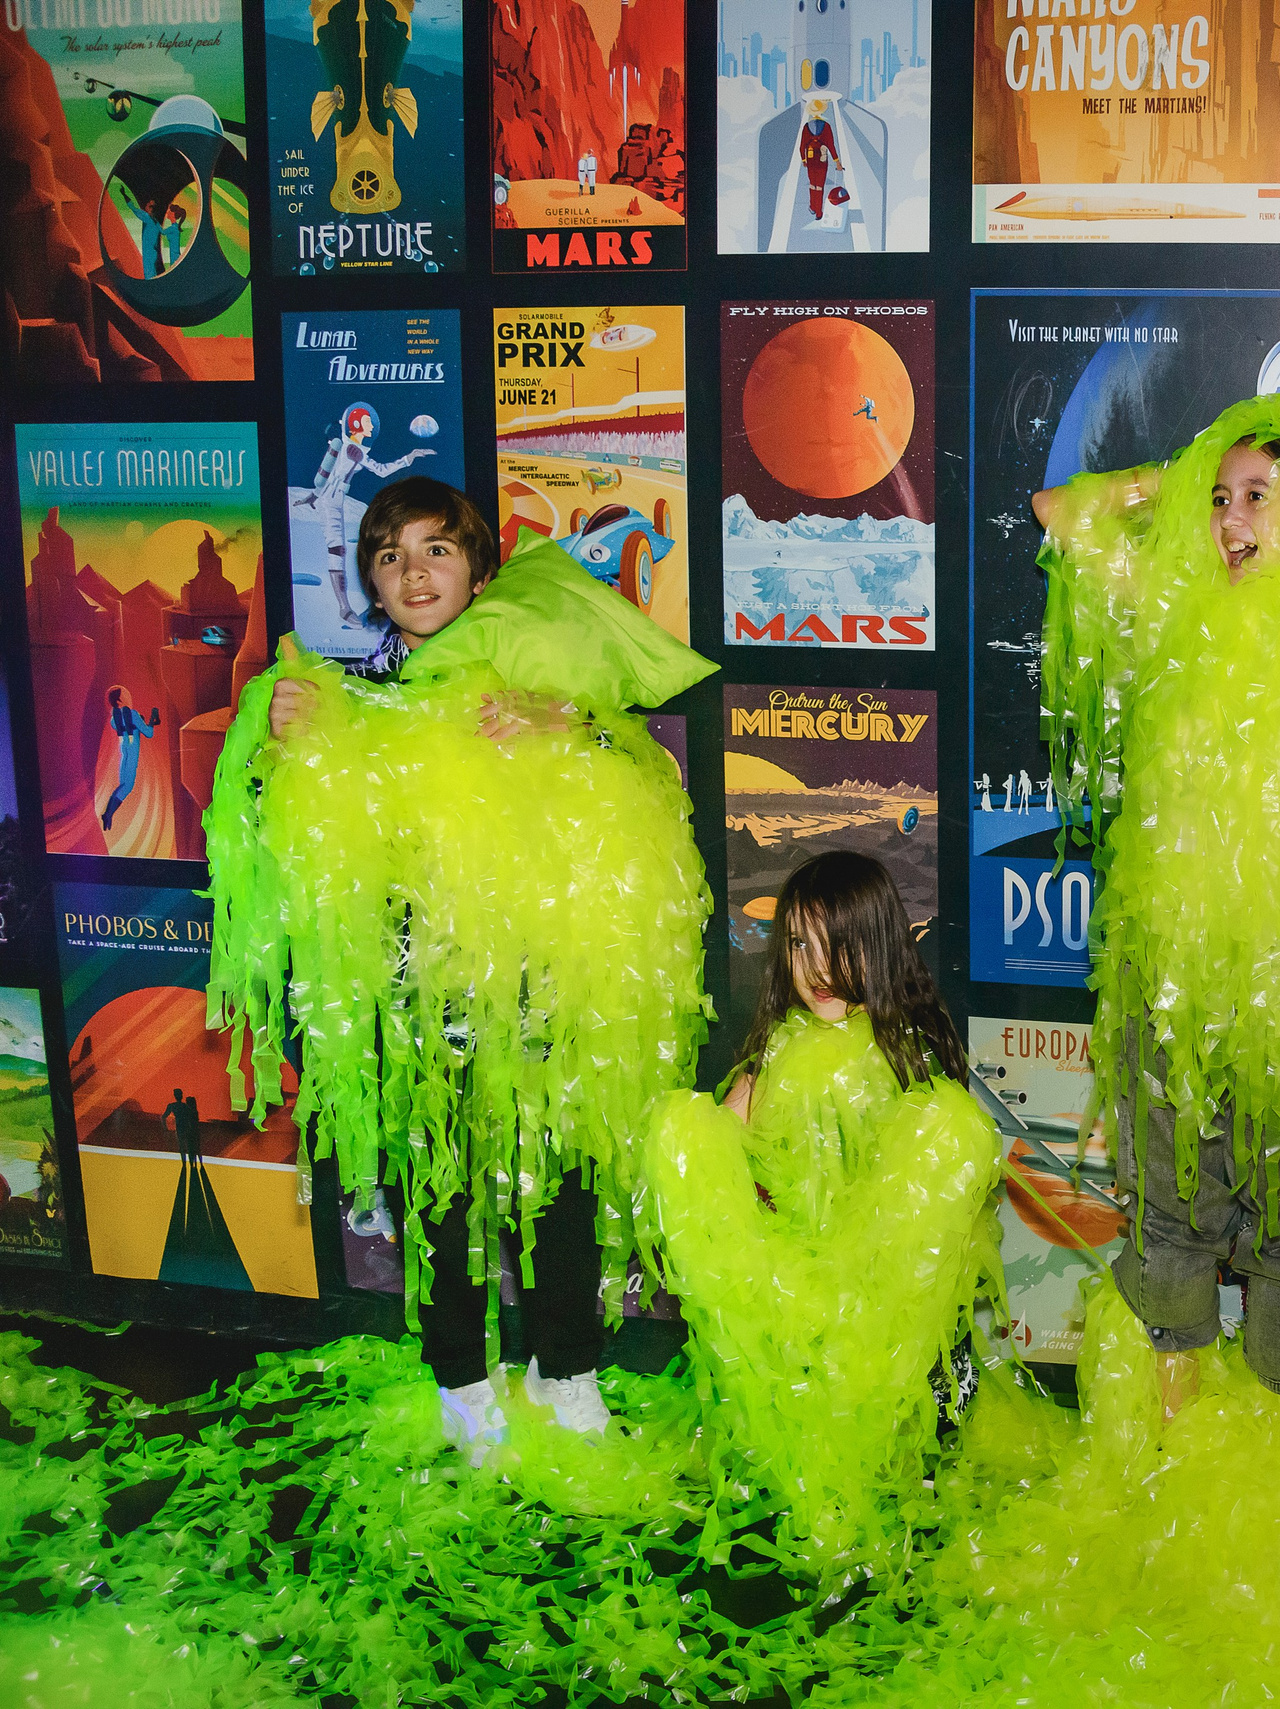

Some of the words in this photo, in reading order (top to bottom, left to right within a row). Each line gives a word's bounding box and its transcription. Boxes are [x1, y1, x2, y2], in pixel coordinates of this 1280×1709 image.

[60, 35, 80, 53] The
[85, 35, 108, 51] solar
[112, 34, 152, 57] system's
[156, 31, 193, 55] highest
[192, 30, 222, 55] peak
[1005, 15, 1210, 91] CANYONS
[1082, 98, 1111, 114] MEET
[1119, 98, 1137, 114] THE
[1144, 95, 1207, 114] MARTIANS!
[285, 149, 305, 160] SAIL
[281, 167, 310, 178] UNDER
[278, 185, 296, 196] THE
[300, 184, 314, 195] ICE
[288, 202, 303, 213] OF
[545, 208, 590, 217] GUERILLA
[558, 217, 598, 226] SCIENCE
[300, 222, 433, 259] NEPTUNE
[526, 231, 653, 267] MARS
[729, 306, 769, 316] FLY
[773, 306, 820, 316] HIGH
[823, 306, 850, 315] ON
[854, 306, 928, 316] PHOBOS
[497, 322, 585, 340] GRAND
[1039, 326, 1058, 342] THE
[1062, 327, 1101, 343] PLANET
[1104, 327, 1130, 343] WITH
[1134, 327, 1148, 343] NO
[1152, 327, 1178, 343] STAR
[498, 342, 586, 368] PRIX
[499, 378, 543, 389] THURSDAY,
[499, 390, 536, 406] JUNE
[541, 389, 556, 405] 21
[29, 450, 105, 487] VALLES
[117, 449, 246, 487] MARINERIS
[589, 544, 603, 561] 6
[776, 602, 788, 610] A
[791, 603, 844, 611] SHORT
[877, 605, 926, 613] FROM
[735, 612, 927, 645] MARS
[768, 689, 825, 712] Outrun
[828, 693, 849, 710] the
[848, 693, 888, 718] Sun
[731, 708, 929, 743] MERCURY
[1003, 866, 1090, 951] PSO
[64, 912, 157, 940] PHOBOS
[163, 919, 180, 940] &
[67, 938, 87, 946] TAKE
[96, 941, 136, 950] SPACE-AGE
[138, 944, 166, 952] CRUISE
[168, 946, 199, 954] ABOARD
[1000, 1027, 1091, 1062] EUROPA
[1041, 1329, 1068, 1339] WAKE
[1041, 1341, 1075, 1350] AGING
